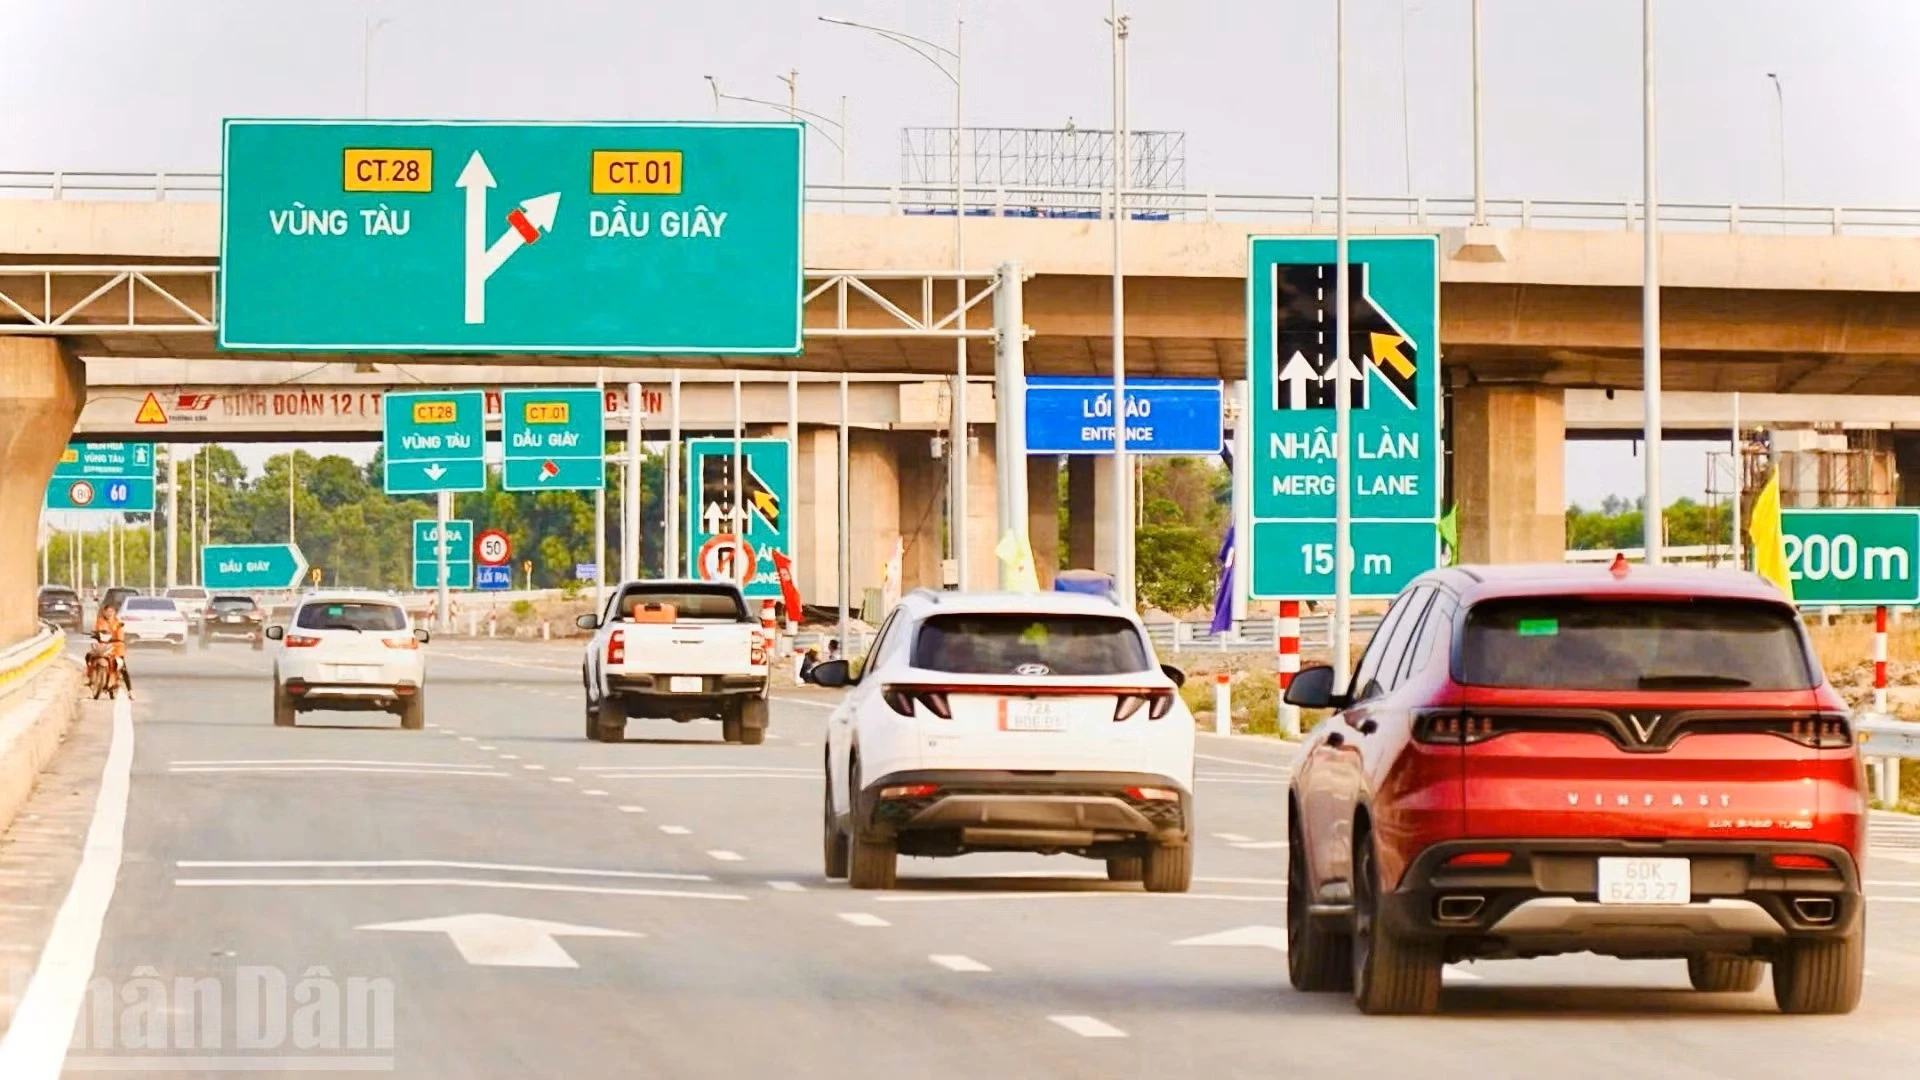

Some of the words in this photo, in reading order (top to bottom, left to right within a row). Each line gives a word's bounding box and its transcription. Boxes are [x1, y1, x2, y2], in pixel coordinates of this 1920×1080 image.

[357, 160, 420, 182] CT.28
[609, 160, 671, 184] CT.01
[269, 201, 348, 236] VŨNG
[360, 203, 410, 236] TÀU
[590, 199, 650, 238] DẦU
[660, 204, 728, 238] GIÂY
[331, 393, 352, 415] 12
[1084, 392, 1112, 417] LỐI
[1123, 394, 1151, 417] ÀO
[1082, 427, 1154, 441] ENTRNCE
[1358, 425, 1419, 459] LÀN
[110, 484, 127, 501] 60
[1272, 475, 1337, 496] MERG
[1357, 475, 1419, 496] LANE
[486, 541, 501, 555] 50
[1363, 553, 1392, 575] m
[1567, 792, 1730, 806] VINFAST
